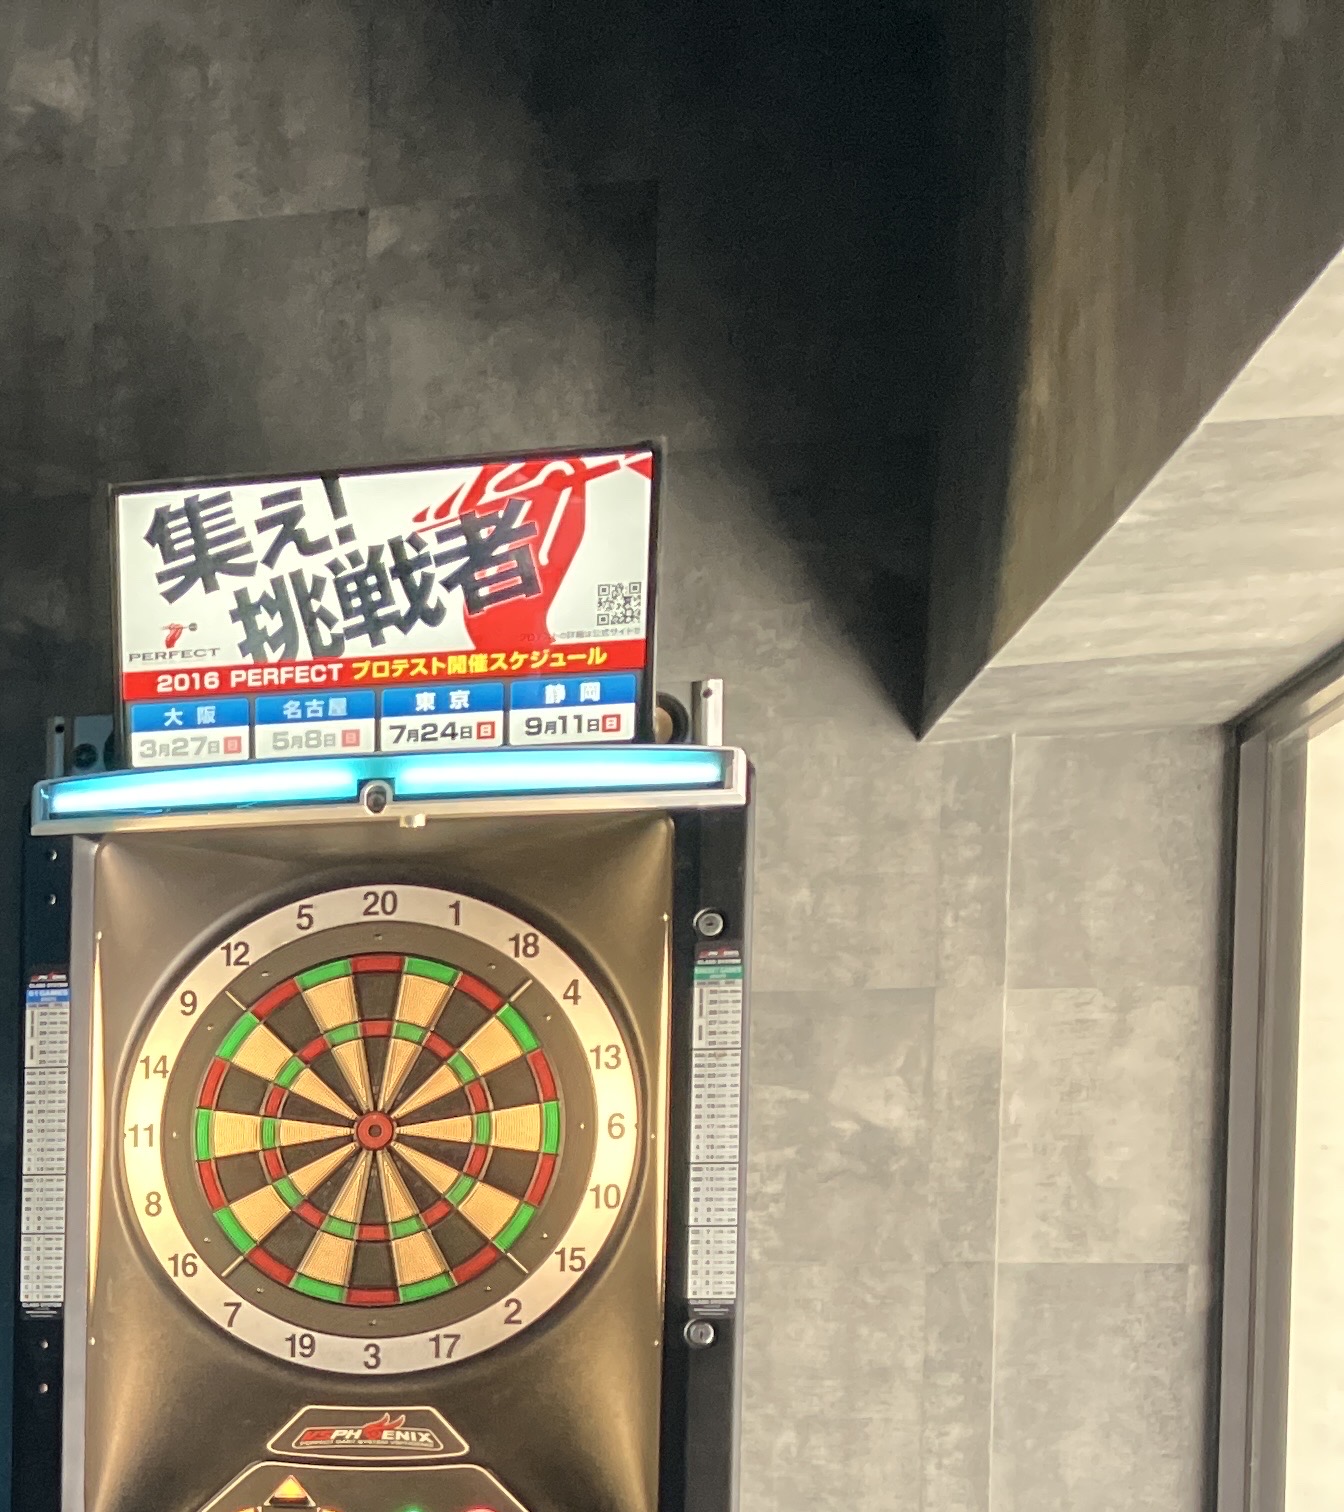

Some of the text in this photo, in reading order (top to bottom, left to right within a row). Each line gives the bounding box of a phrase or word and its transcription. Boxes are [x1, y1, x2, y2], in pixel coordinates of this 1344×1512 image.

[229, 498, 543, 664] 挑戦者
[128, 647, 220, 663] PERFECT
[156, 646, 608, 693] 2016 PERFECT プロテスト開催スケジュール
[283, 697, 348, 719] 名古屋
[363, 892, 398, 916] 20
[449, 902, 461, 926] 1
[296, 906, 314, 928] 5
[221, 942, 250, 966] 12
[508, 934, 539, 958] 18
[180, 992, 198, 1015] 9
[562, 980, 582, 1004] 4
[139, 1056, 169, 1079] 14
[590, 1046, 621, 1070] 13
[129, 1125, 156, 1147] 11
[608, 1115, 625, 1138] 6
[145, 1192, 163, 1215] 8
[591, 1185, 621, 1209] 10
[168, 1255, 198, 1278] 16
[555, 1248, 585, 1272] 15
[224, 1304, 242, 1327] 7
[504, 1300, 522, 1324] 2
[286, 1335, 316, 1358] 19
[363, 1344, 381, 1368] 3
[429, 1334, 460, 1358] 17
